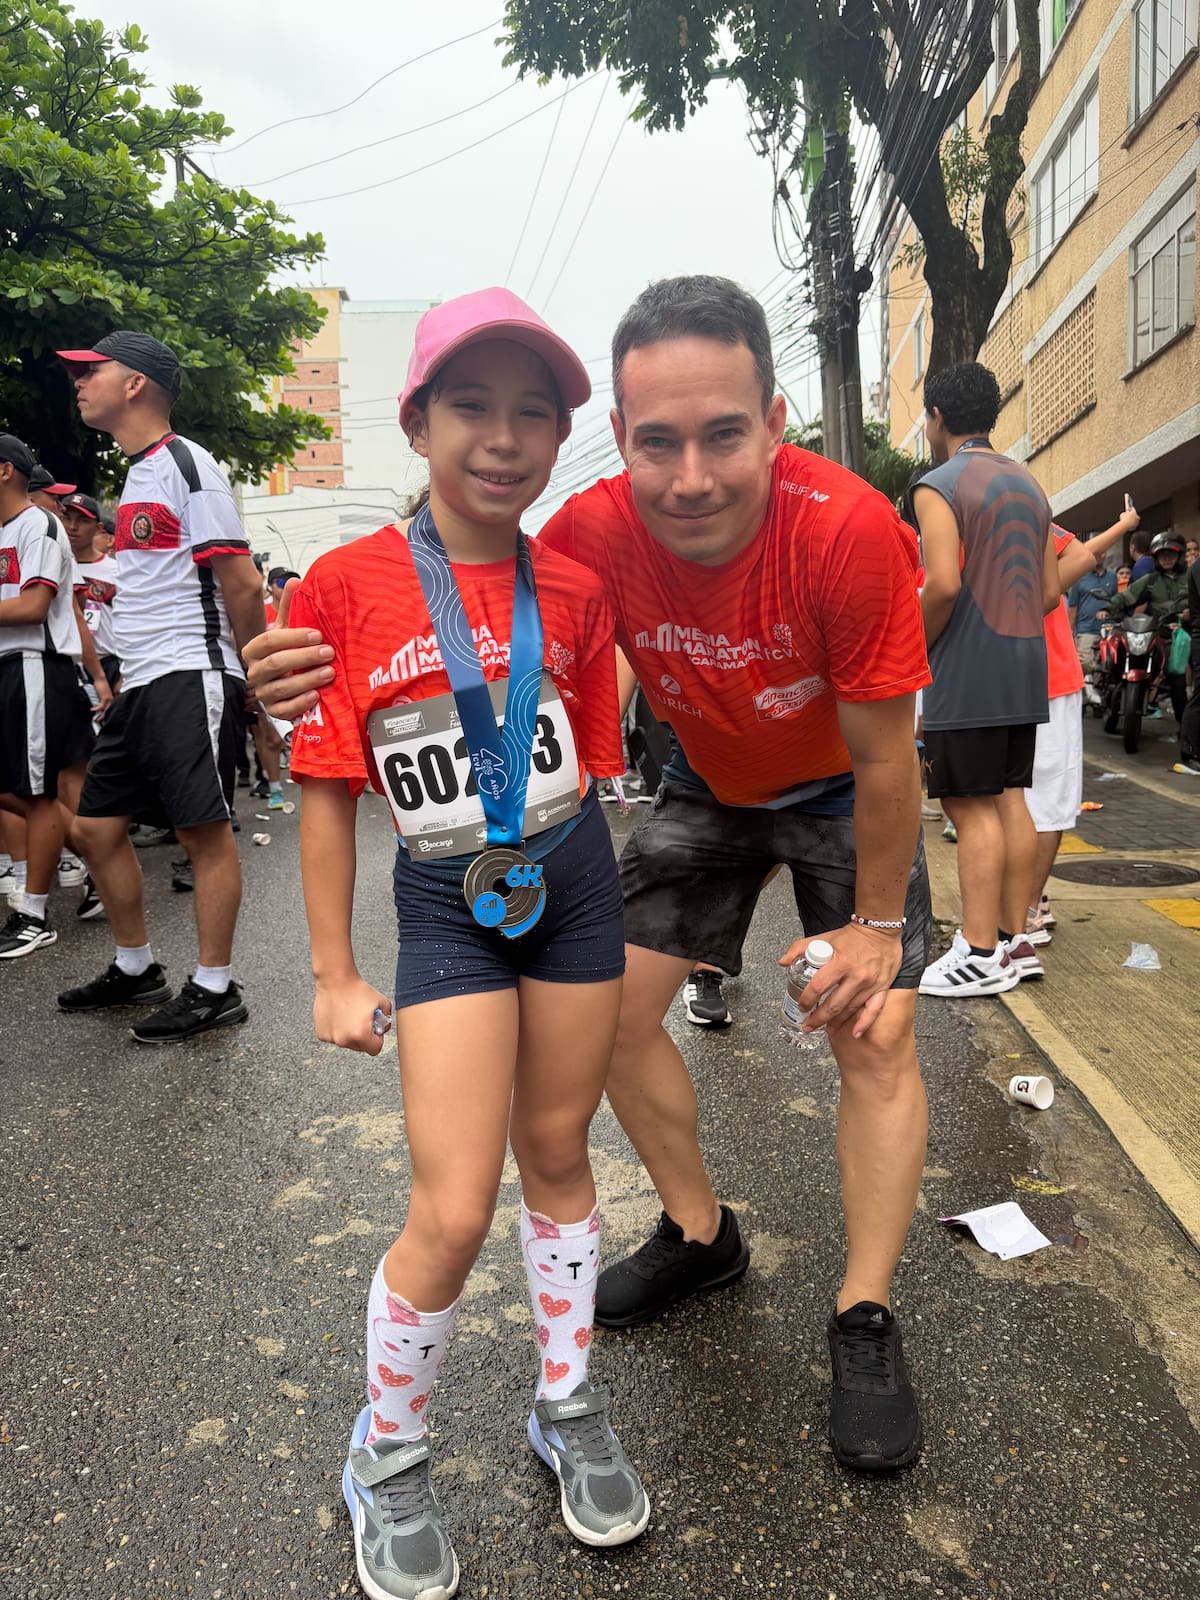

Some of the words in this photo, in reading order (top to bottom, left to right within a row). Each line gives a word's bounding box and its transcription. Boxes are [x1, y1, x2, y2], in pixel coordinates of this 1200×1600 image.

[417, 624, 493, 650] MIA
[674, 624, 730, 647] MEDIA
[383, 714, 562, 811] 6023
[505, 865, 543, 888] 6K
[558, 1401, 588, 1414] Reebok
[398, 1445, 429, 1464] Reebok
